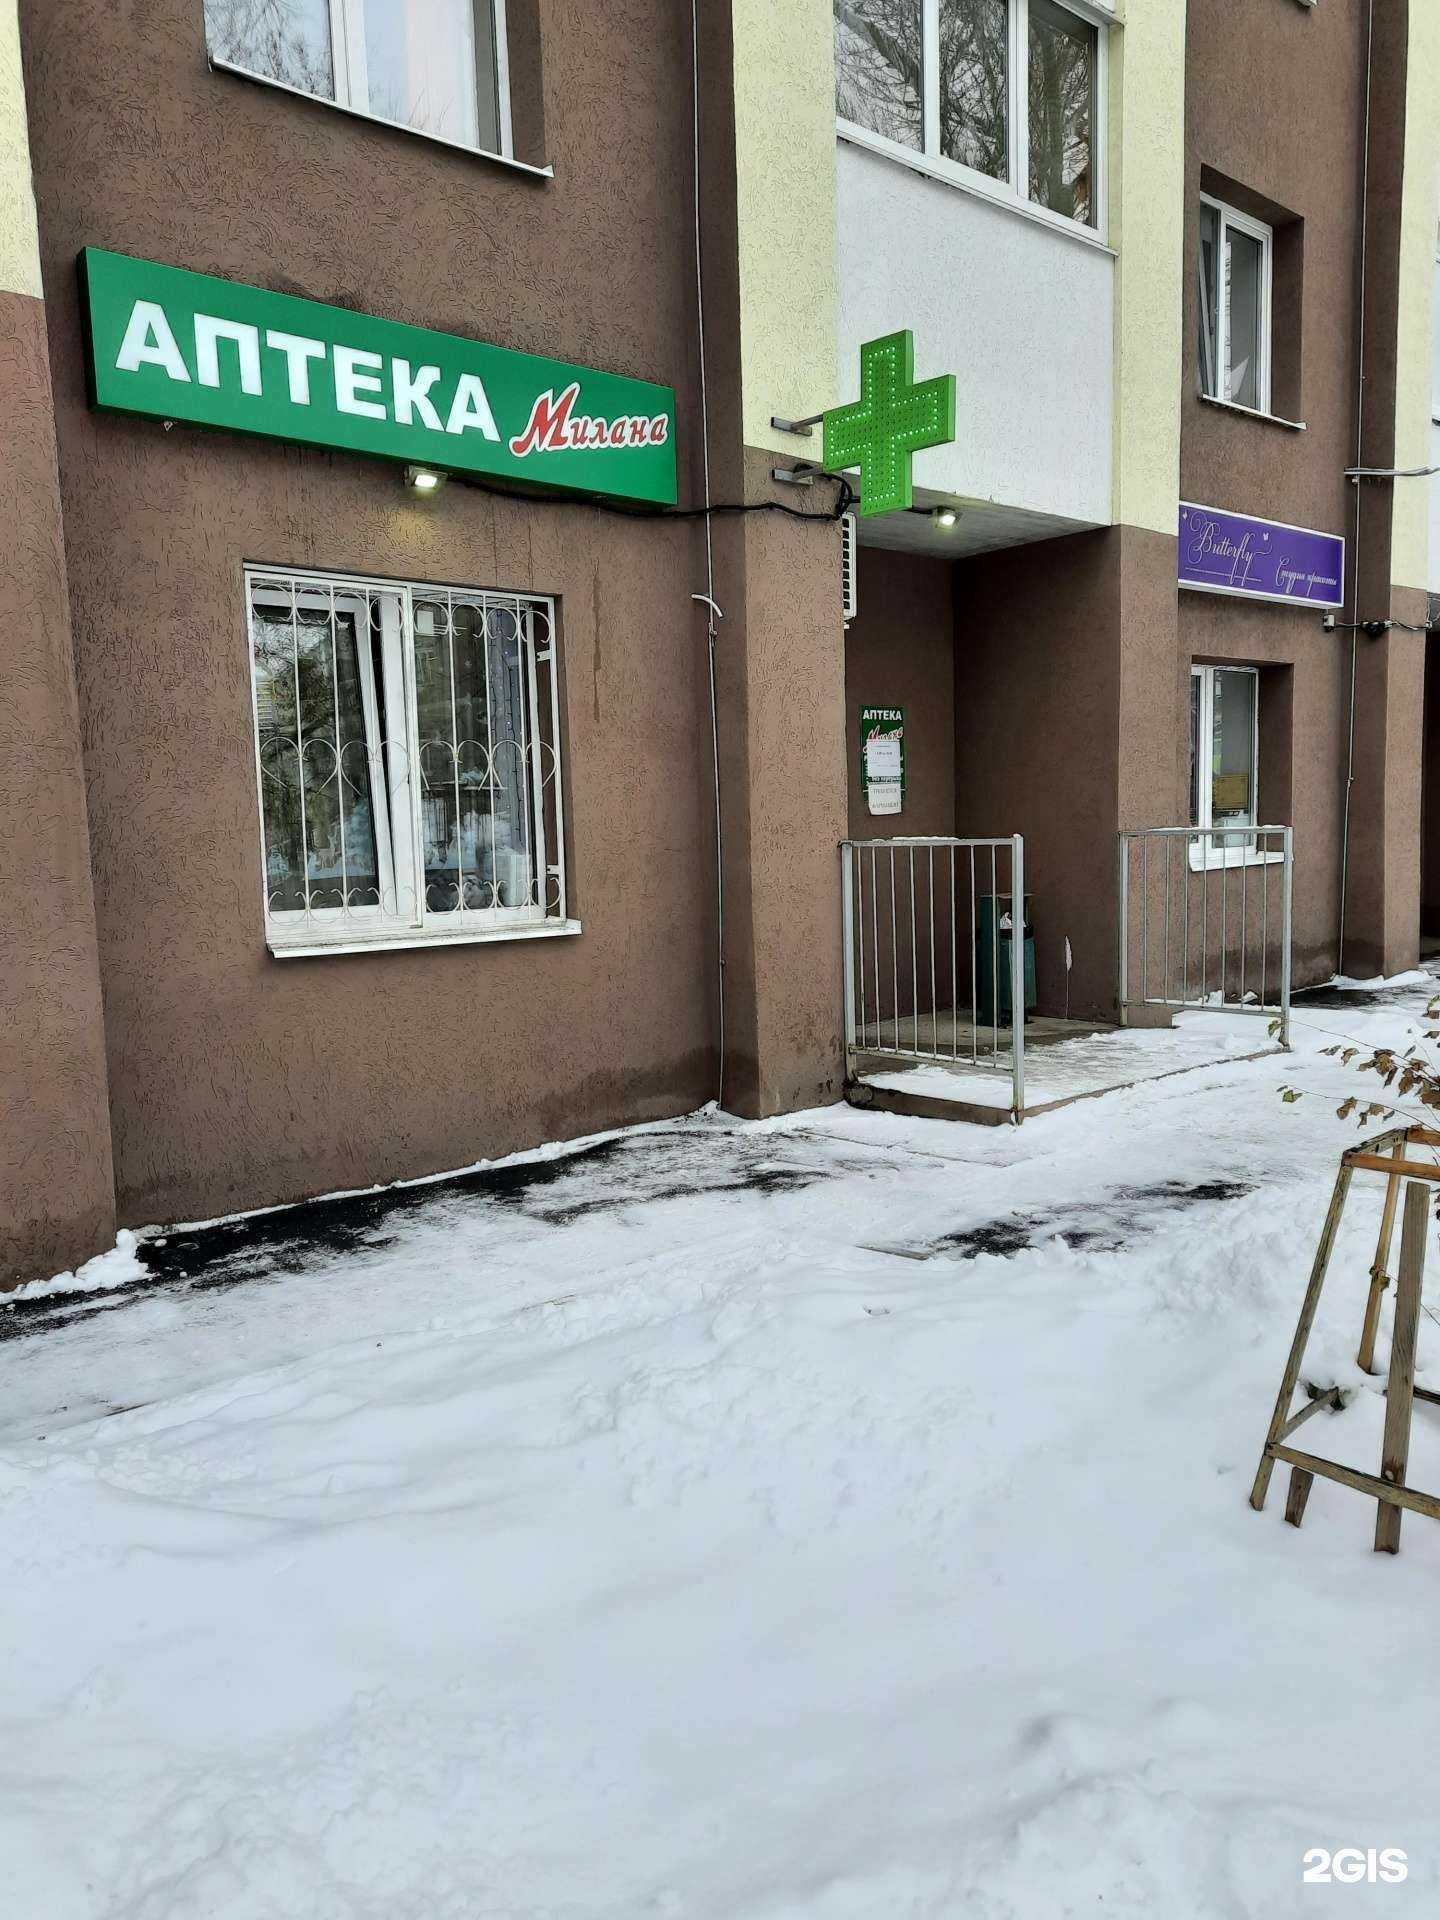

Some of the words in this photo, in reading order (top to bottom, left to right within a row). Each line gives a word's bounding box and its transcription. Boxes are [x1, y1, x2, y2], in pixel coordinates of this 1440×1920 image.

[115, 299, 501, 442] АПТЕКА
[508, 381, 669, 458] Милана
[1188, 511, 1272, 586] Butterfly
[862, 709, 902, 721] АПТЕКА
